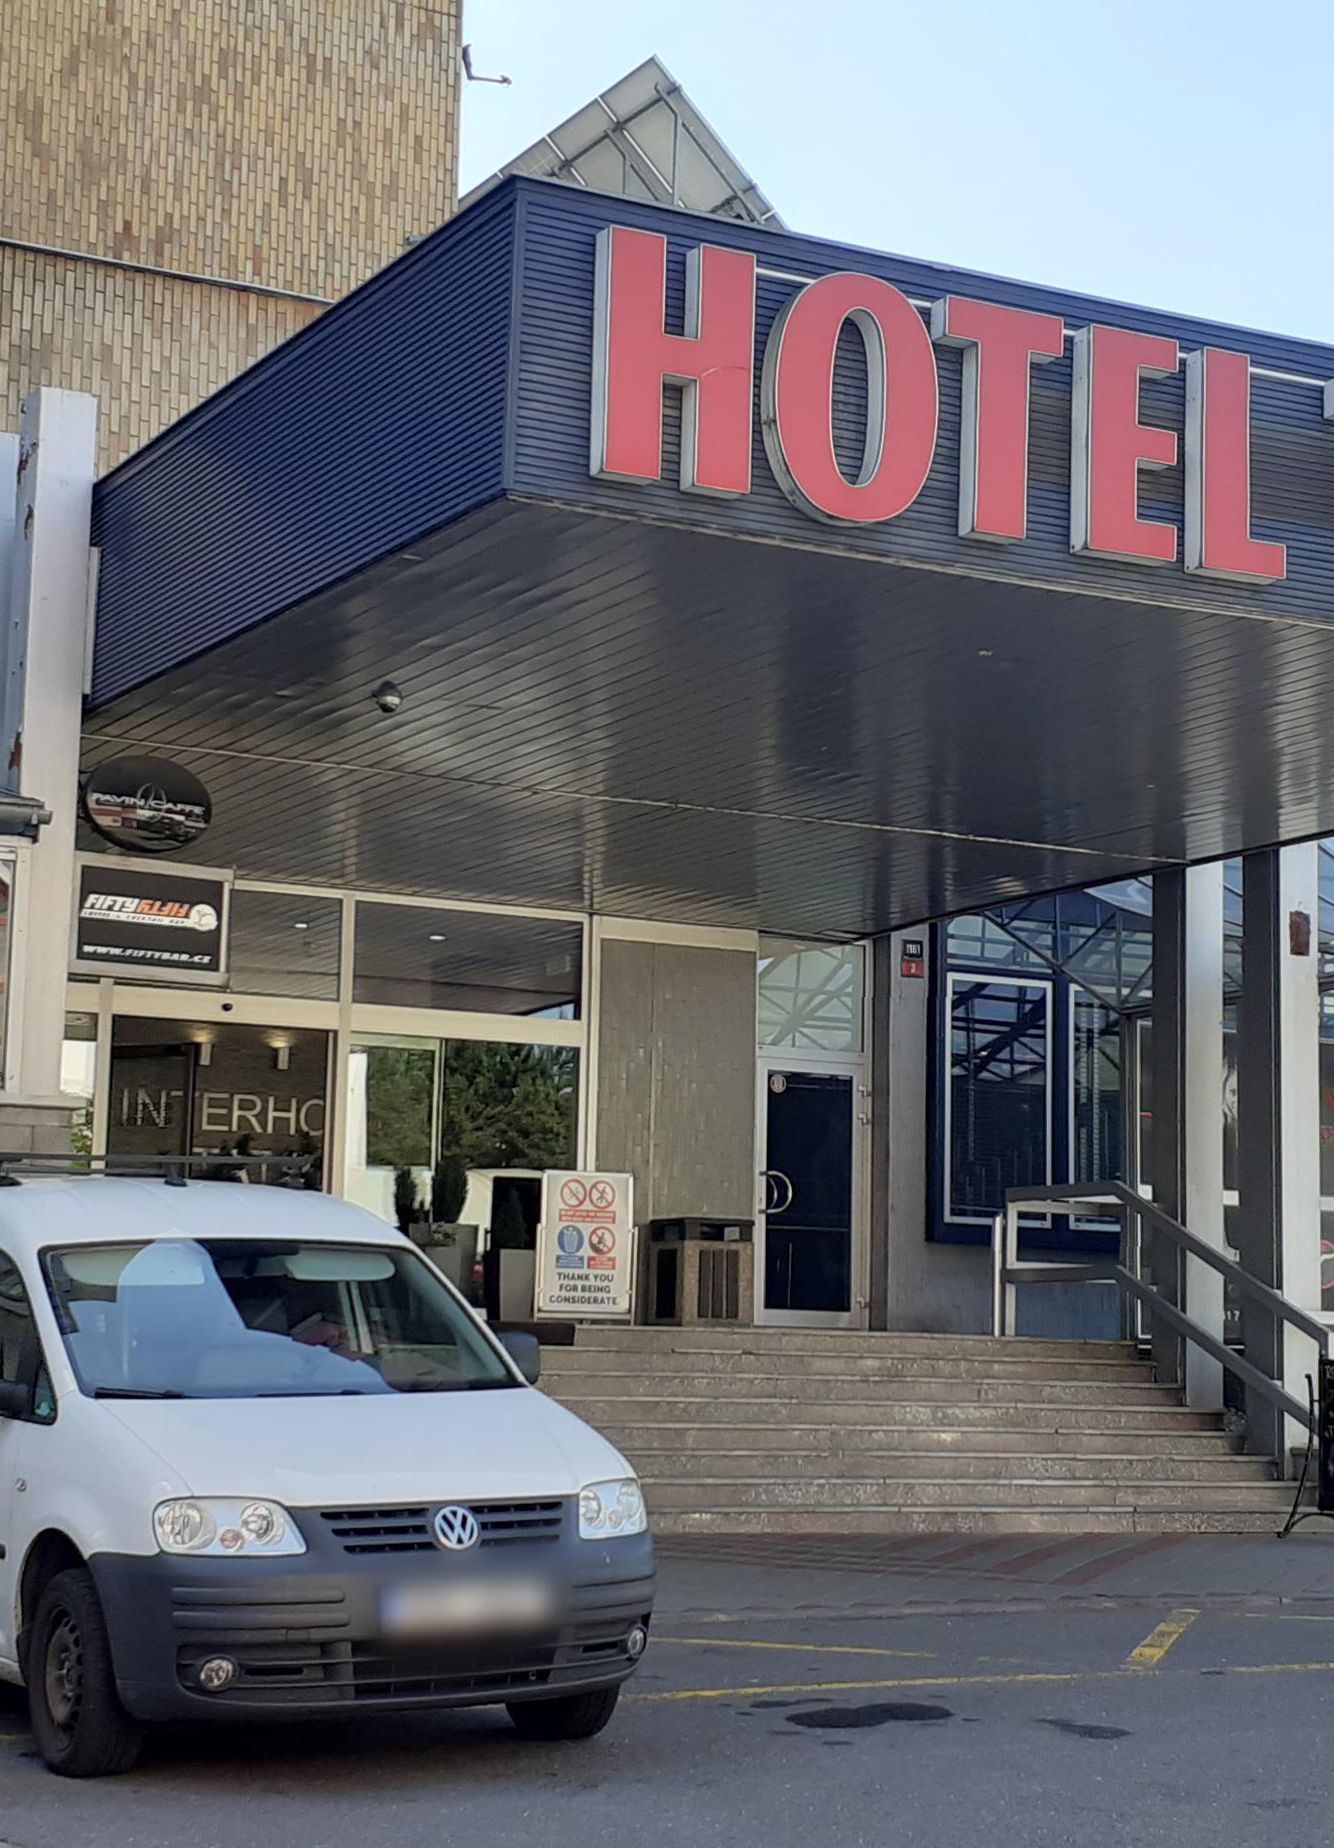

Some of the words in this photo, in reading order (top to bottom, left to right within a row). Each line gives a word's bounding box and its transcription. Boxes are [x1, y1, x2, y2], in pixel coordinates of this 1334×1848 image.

[589, 224, 1287, 582] HOTEL
[84, 893, 140, 912] FIFTY
[557, 1272, 590, 1283] THANK
[593, 1273, 615, 1283] YOU
[559, 1284, 578, 1293] FOR
[581, 1284, 611, 1294] BEING
